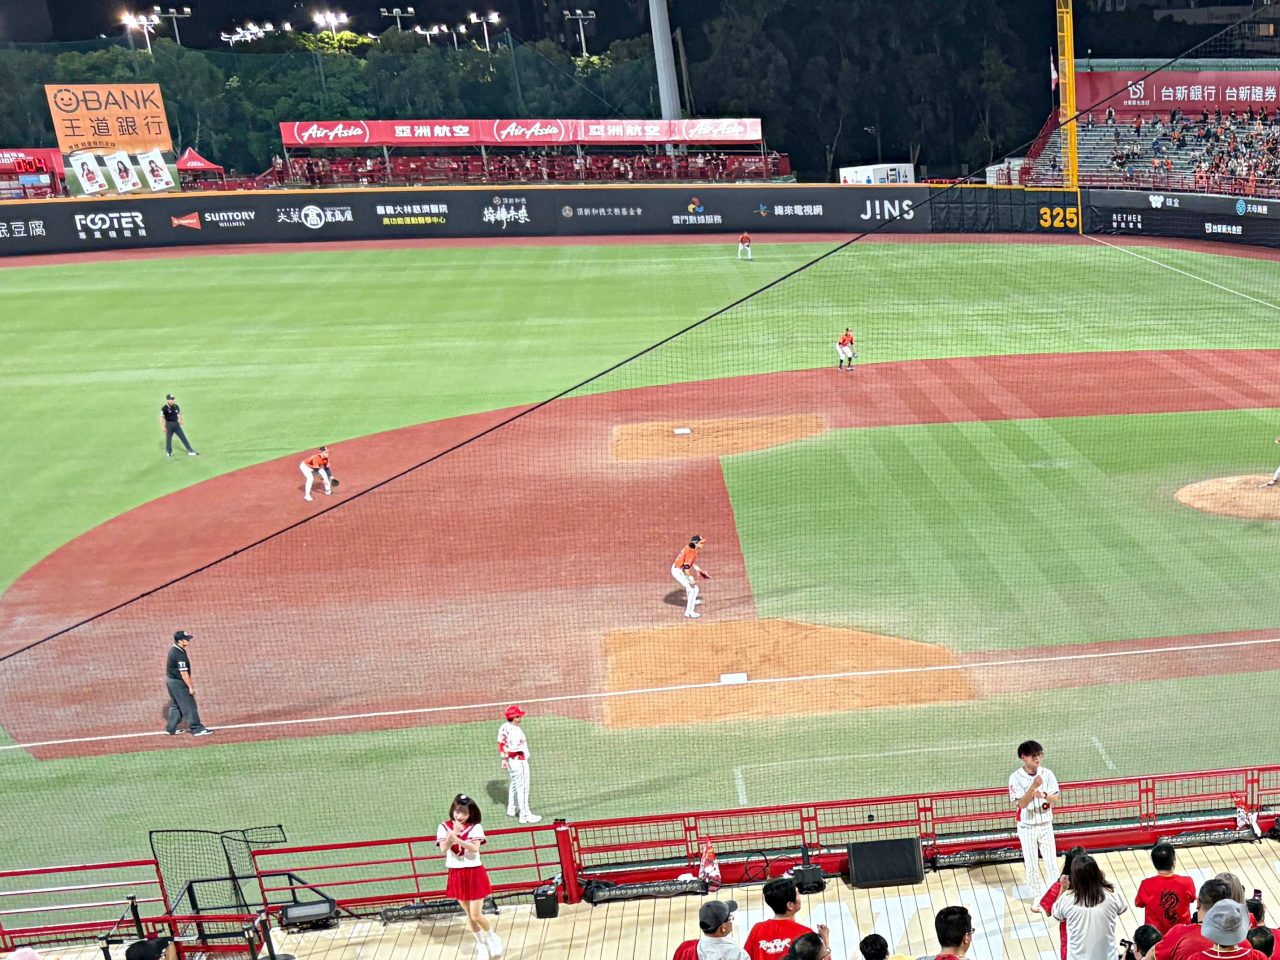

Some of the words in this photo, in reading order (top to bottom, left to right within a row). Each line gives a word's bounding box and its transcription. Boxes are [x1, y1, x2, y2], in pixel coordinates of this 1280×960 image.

[1160, 85, 1216, 102] 台新銀行
[1225, 85, 1277, 102] 台新證券
[62, 115, 163, 137] 王道銀行
[394, 125, 470, 137] 亞洲航空
[589, 124, 660, 136] 亞洲航空
[74, 212, 145, 231] FOOTER
[1039, 207, 1078, 228] 325
[1112, 213, 1142, 222] AETHER
